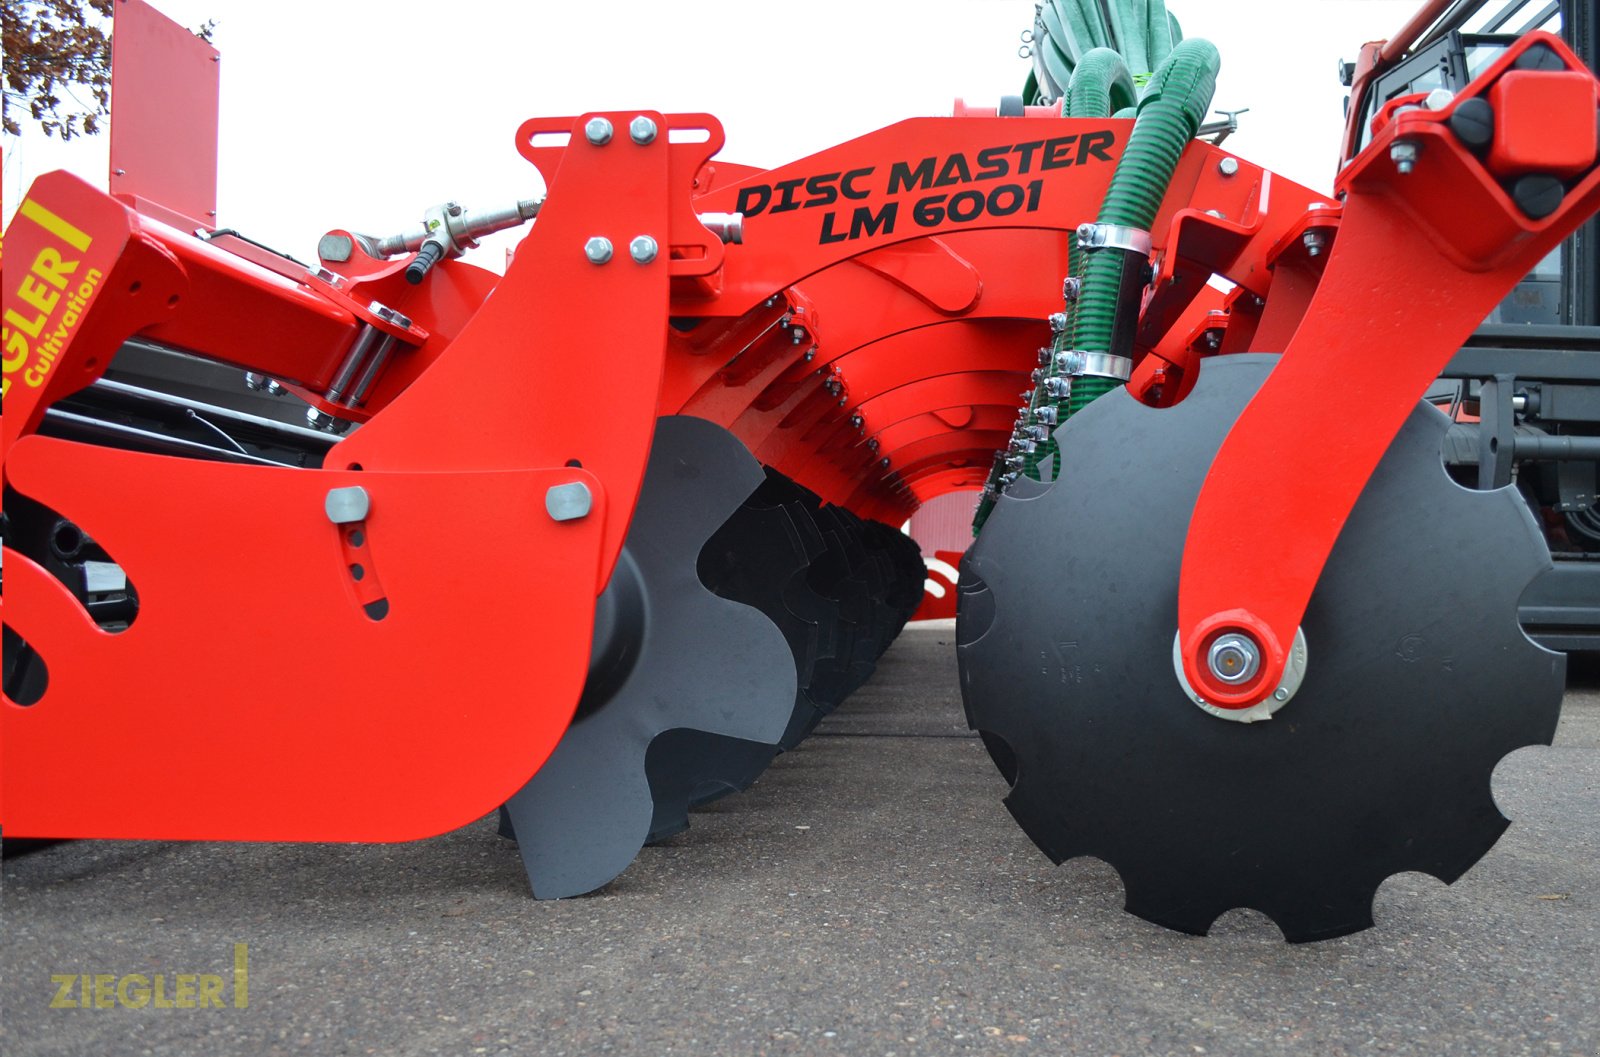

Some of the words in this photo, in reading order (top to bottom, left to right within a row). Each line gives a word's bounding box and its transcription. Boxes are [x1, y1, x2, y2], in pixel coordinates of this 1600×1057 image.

[735, 166, 876, 218] DISC
[886, 129, 1114, 195] MASTER
[818, 202, 898, 245] LM
[912, 179, 1043, 227] 6001
[2, 247, 80, 399] GLER
[24, 268, 102, 387] Cultivation
